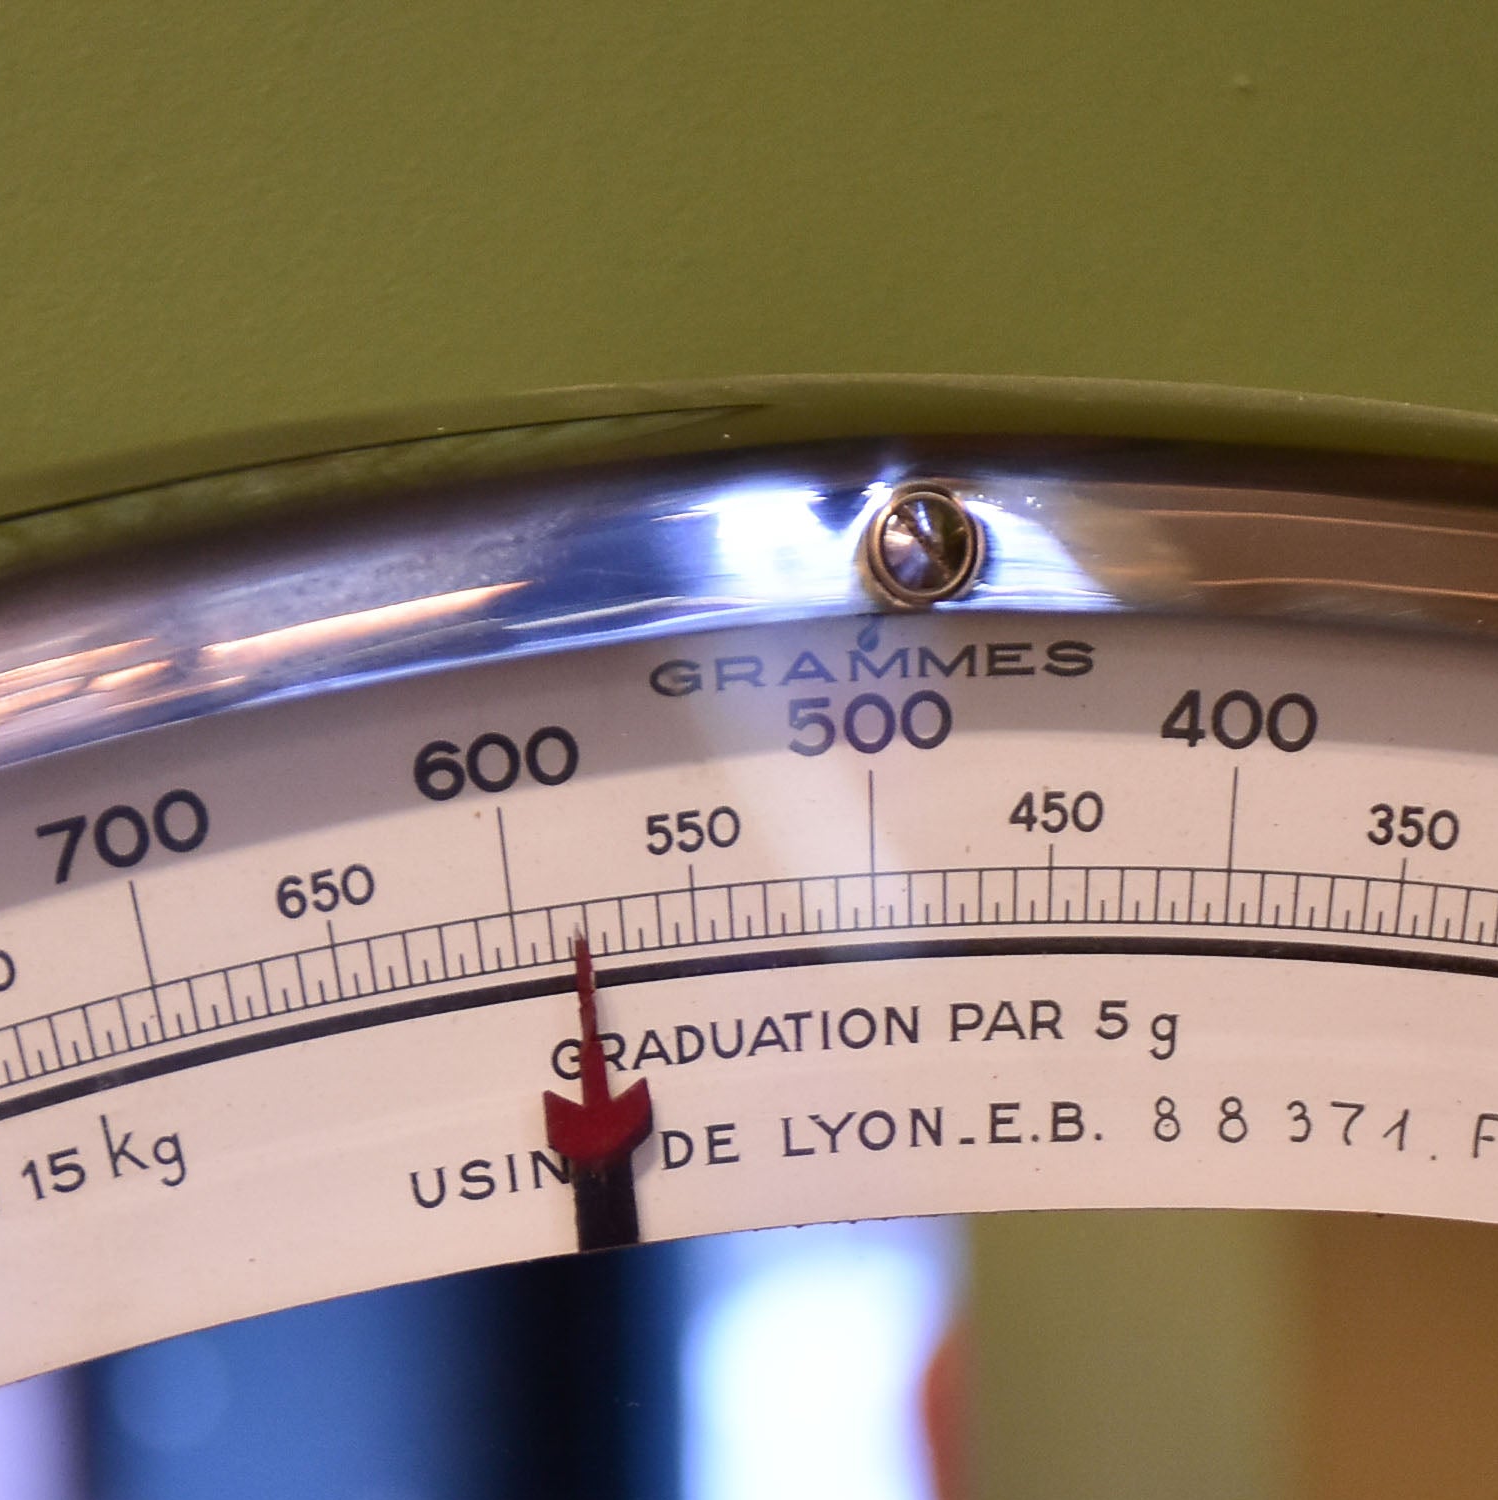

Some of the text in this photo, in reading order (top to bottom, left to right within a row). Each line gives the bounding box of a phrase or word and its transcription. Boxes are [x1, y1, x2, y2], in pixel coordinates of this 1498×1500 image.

[650, 639, 1096, 697] GRAMMES
[791, 690, 952, 756] 500
[1161, 690, 1317, 752] 400
[414, 726, 579, 801] 600
[36, 789, 209, 884] 700
[647, 806, 740, 855] 550
[1009, 791, 1103, 833] 450
[1367, 804, 1459, 850] 350
[276, 864, 374, 919] 650
[551, 1005, 919, 1081] GRADUATION
[950, 1000, 1063, 1041] PAR
[410, 1149, 571, 1209] USIN
[659, 1123, 739, 1169] DE
